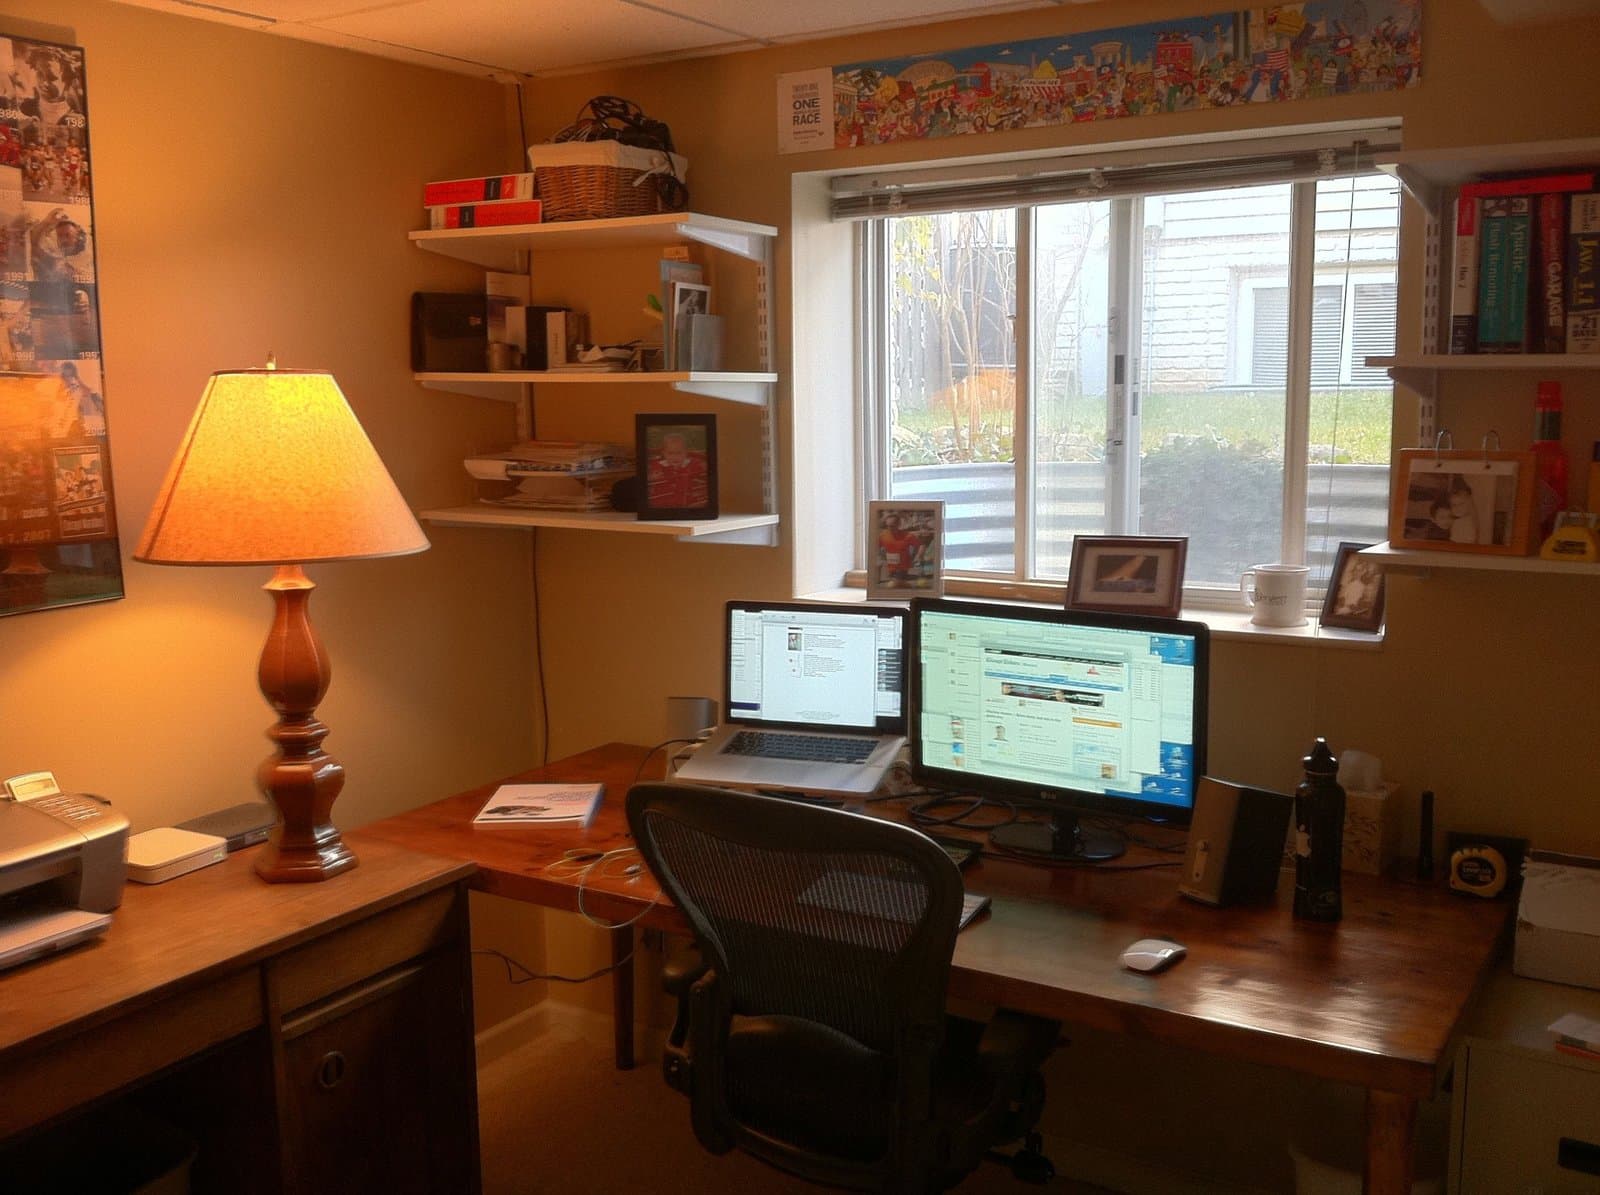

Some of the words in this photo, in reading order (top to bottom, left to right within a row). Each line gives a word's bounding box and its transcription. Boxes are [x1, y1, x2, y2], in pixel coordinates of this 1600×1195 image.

[0, 108, 18, 119] 980
[793, 98, 820, 110] ONE
[793, 113, 821, 125] RACE
[1488, 222, 1501, 249] Flash
[1511, 222, 1528, 273] Apache
[1547, 261, 1563, 327] GARAGE
